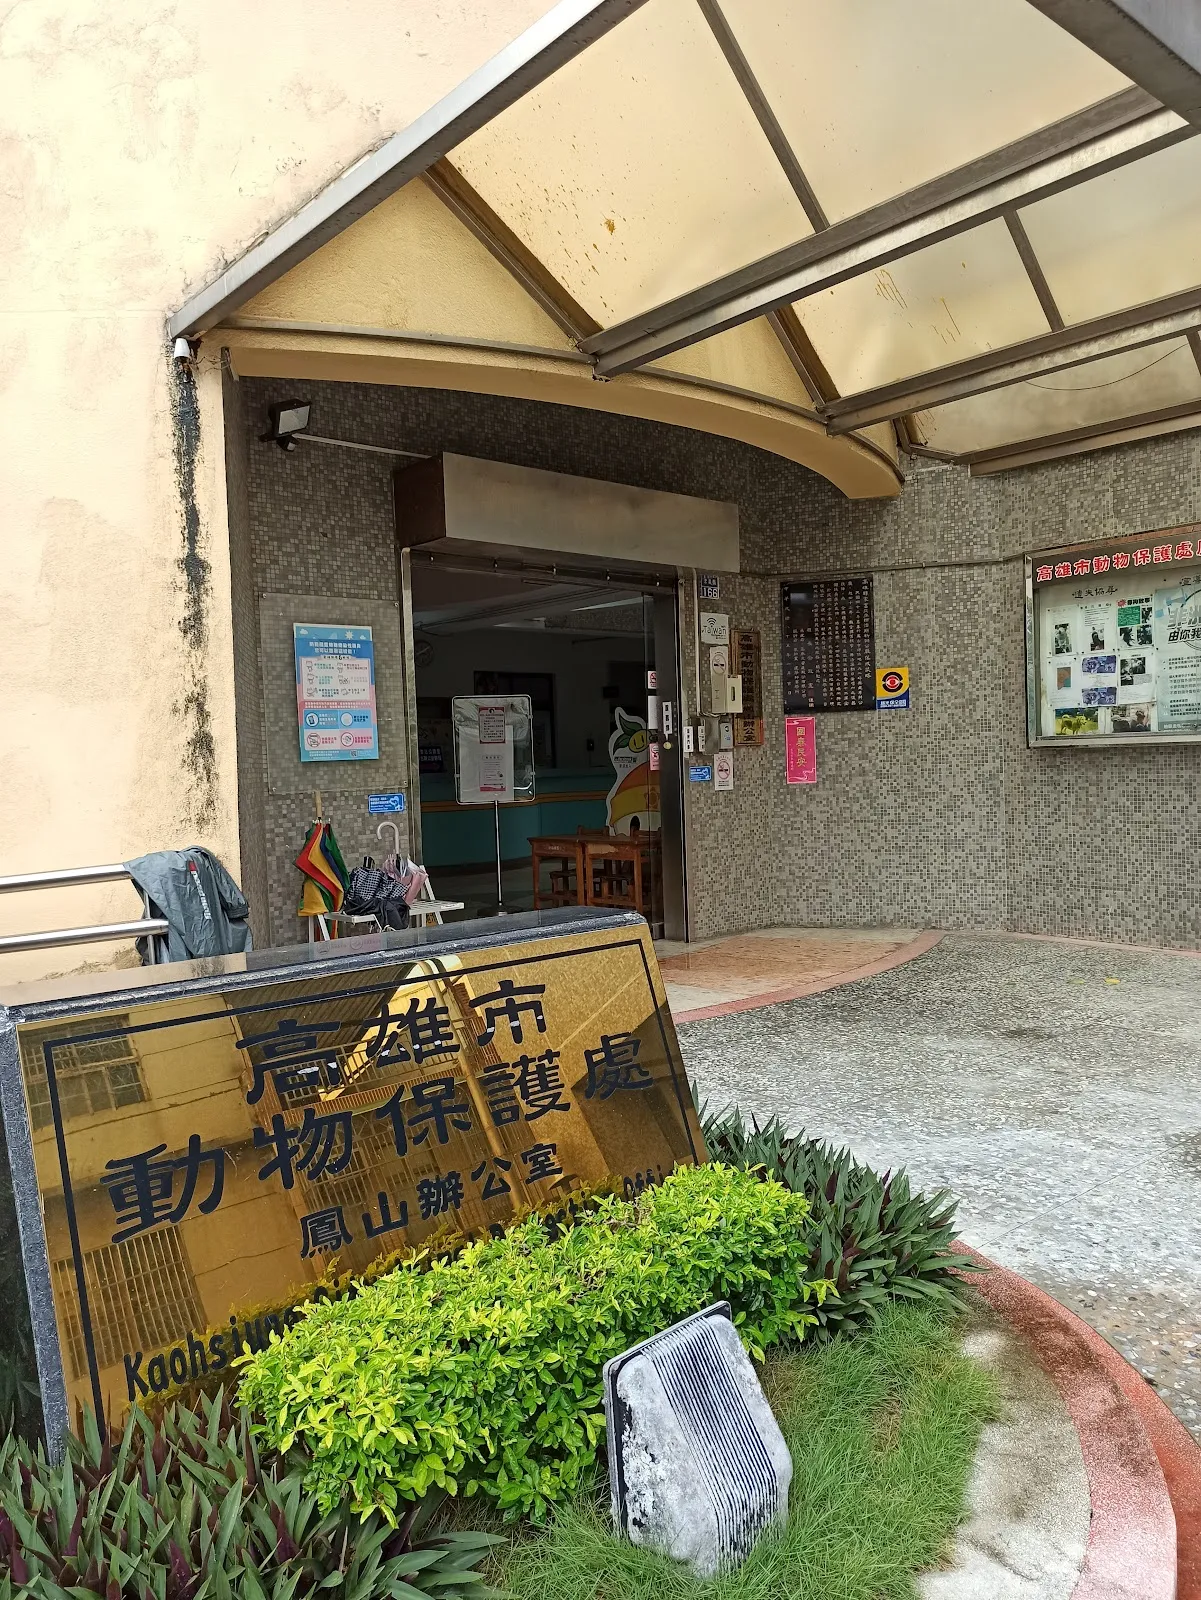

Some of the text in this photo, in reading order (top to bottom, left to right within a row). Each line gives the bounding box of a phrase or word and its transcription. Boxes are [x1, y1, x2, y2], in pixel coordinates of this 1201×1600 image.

[703, 587, 718, 598] 166
[1036, 541, 1201, 582] 高雄市動物保護處
[796, 726, 807, 768] 國泰民安
[235, 979, 547, 1105] 高雄市
[101, 1032, 653, 1244] 動物保護處
[299, 1143, 563, 1260] 鳳山辦公室
